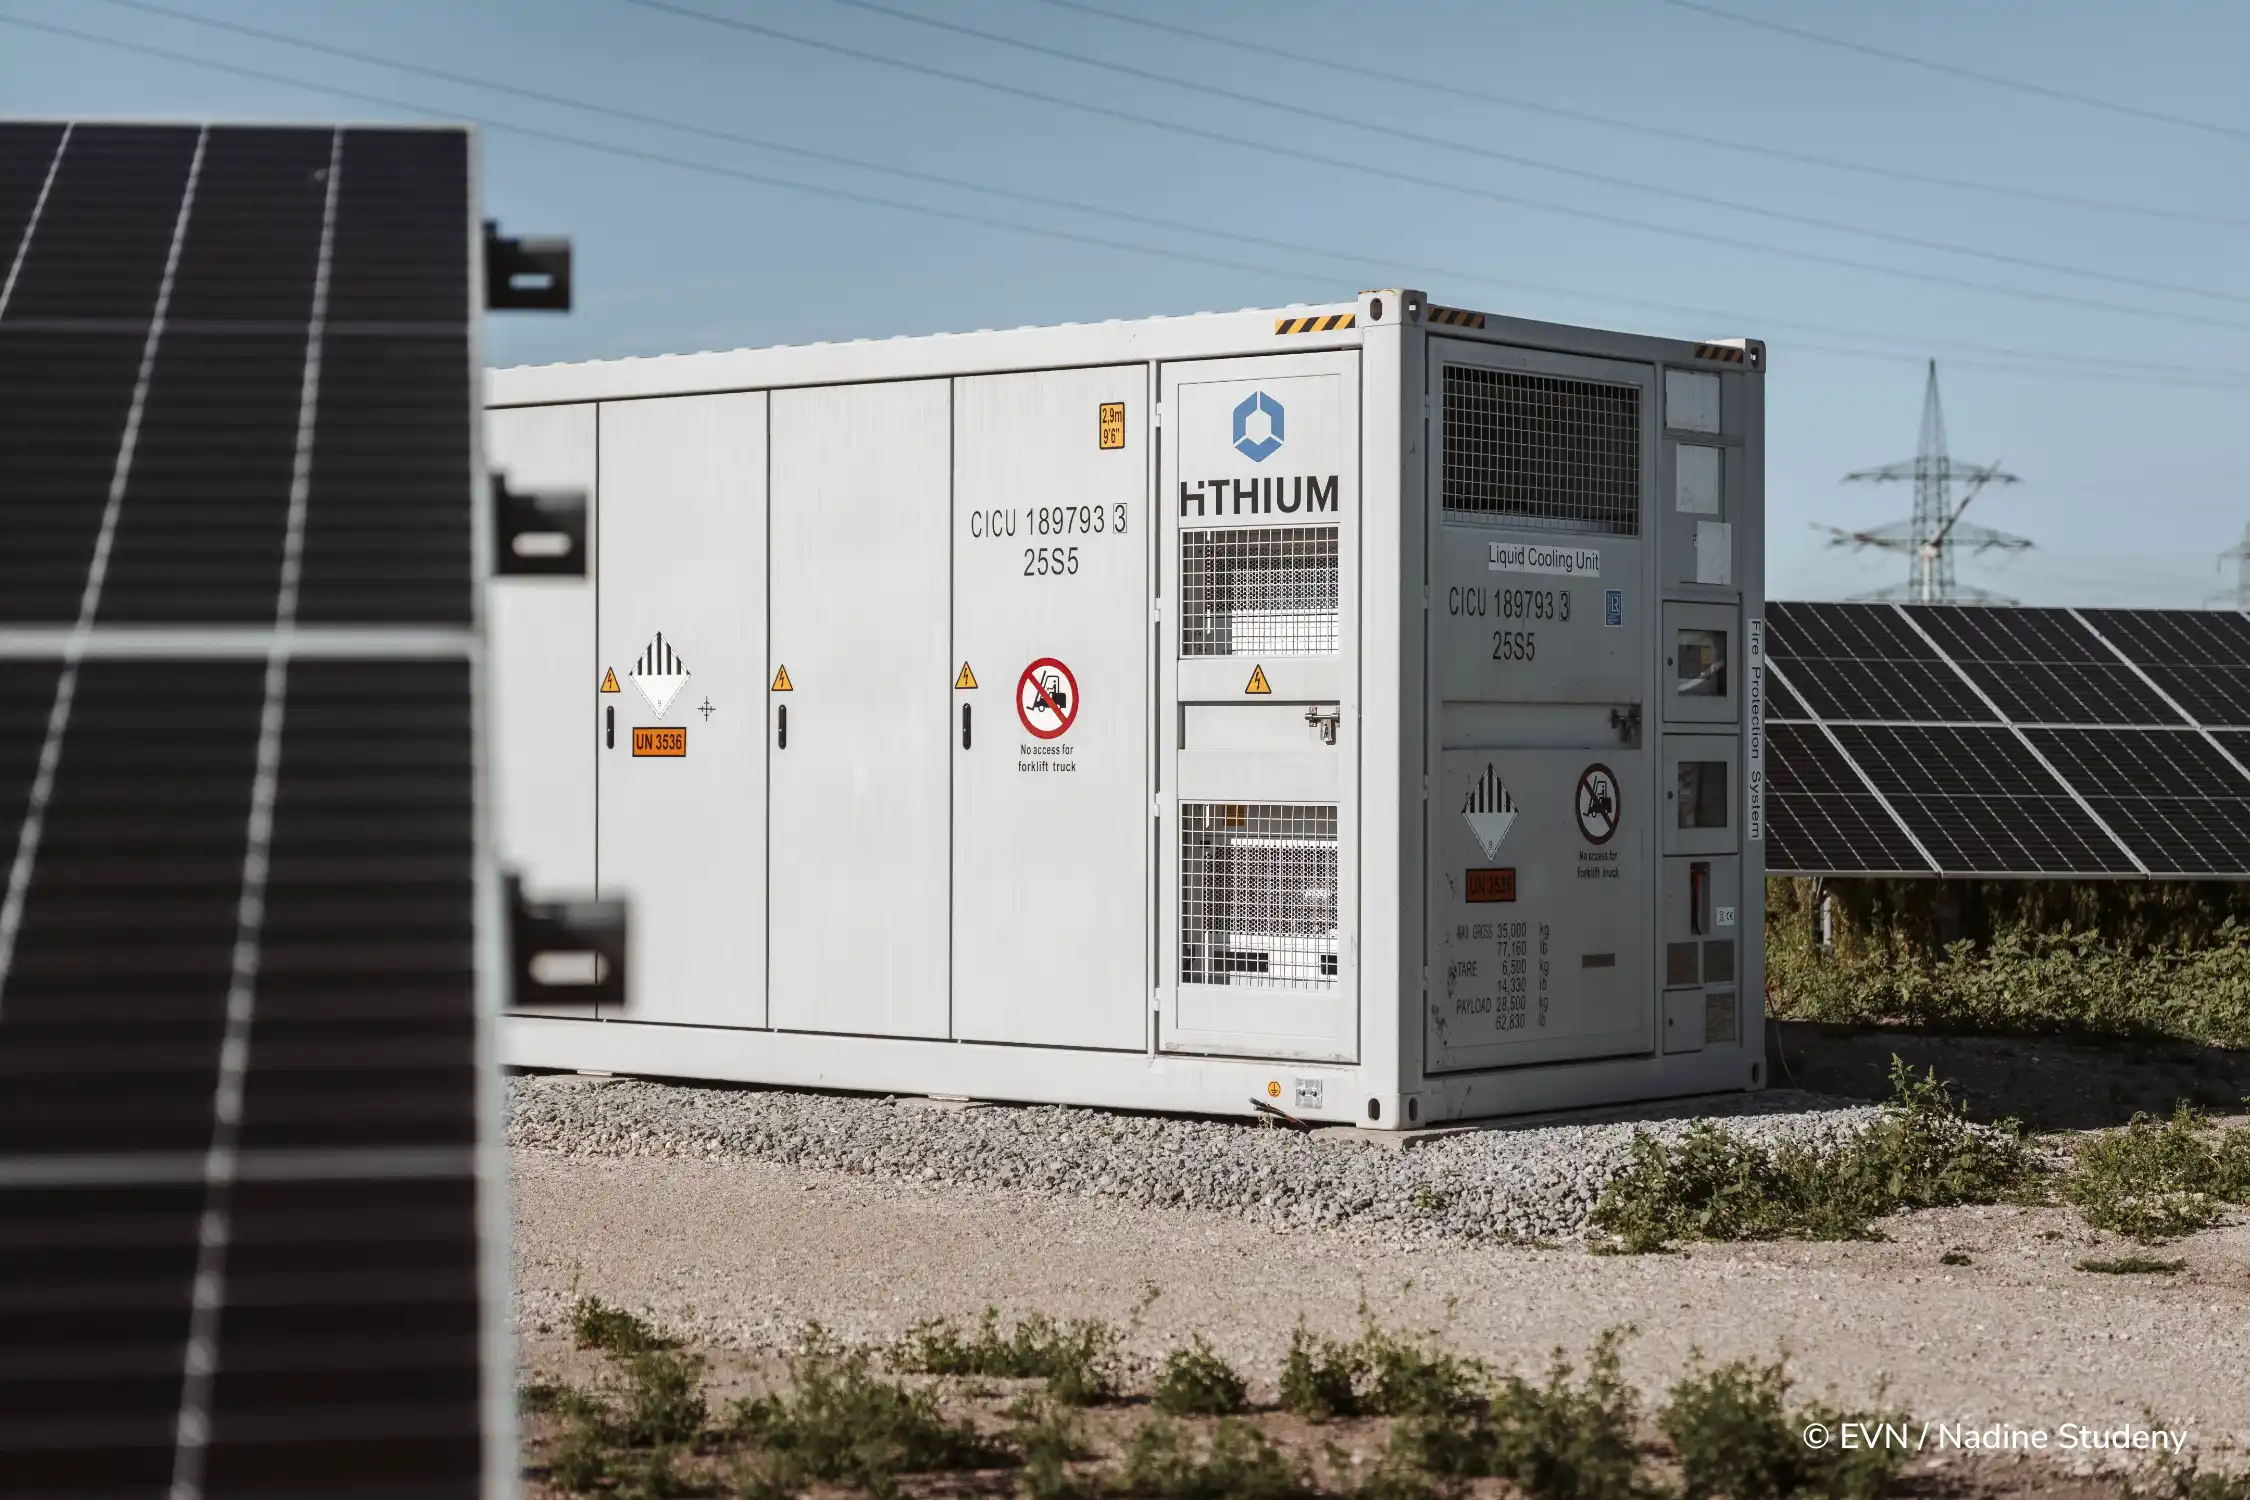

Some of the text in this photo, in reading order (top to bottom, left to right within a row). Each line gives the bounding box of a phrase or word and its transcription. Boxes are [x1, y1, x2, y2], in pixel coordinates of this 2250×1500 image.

[1102, 408, 1122, 426] 2,9m
[971, 504, 1126, 537] CICU 189793 3
[1024, 547, 1079, 576] 25S5
[1489, 544, 1600, 573] Liquid Cooling Unit
[1449, 587, 1569, 621] CICU 189793 3
[1492, 631, 1536, 662] 25S5
[1750, 620, 1761, 838] Fire Protection System
[636, 733, 682, 750] UN 3536
[1020, 744, 1074, 755] No access for
[1018, 761, 1077, 772] forklift truck
[1579, 850, 1587, 861] No
[1577, 867, 1600, 879] forklift
[1469, 876, 1485, 895] UN
[1497, 922, 1527, 940] 35,000
[1539, 921, 1549, 940] kg
[1496, 941, 1527, 958] 77,160
[1457, 959, 1549, 977] TARE 6,500 kg
[1497, 977, 1527, 995] 14,330
[1456, 995, 1549, 1014] PAYLOAD 28,500 kg
[1495, 1013, 1526, 1031] 62,830
